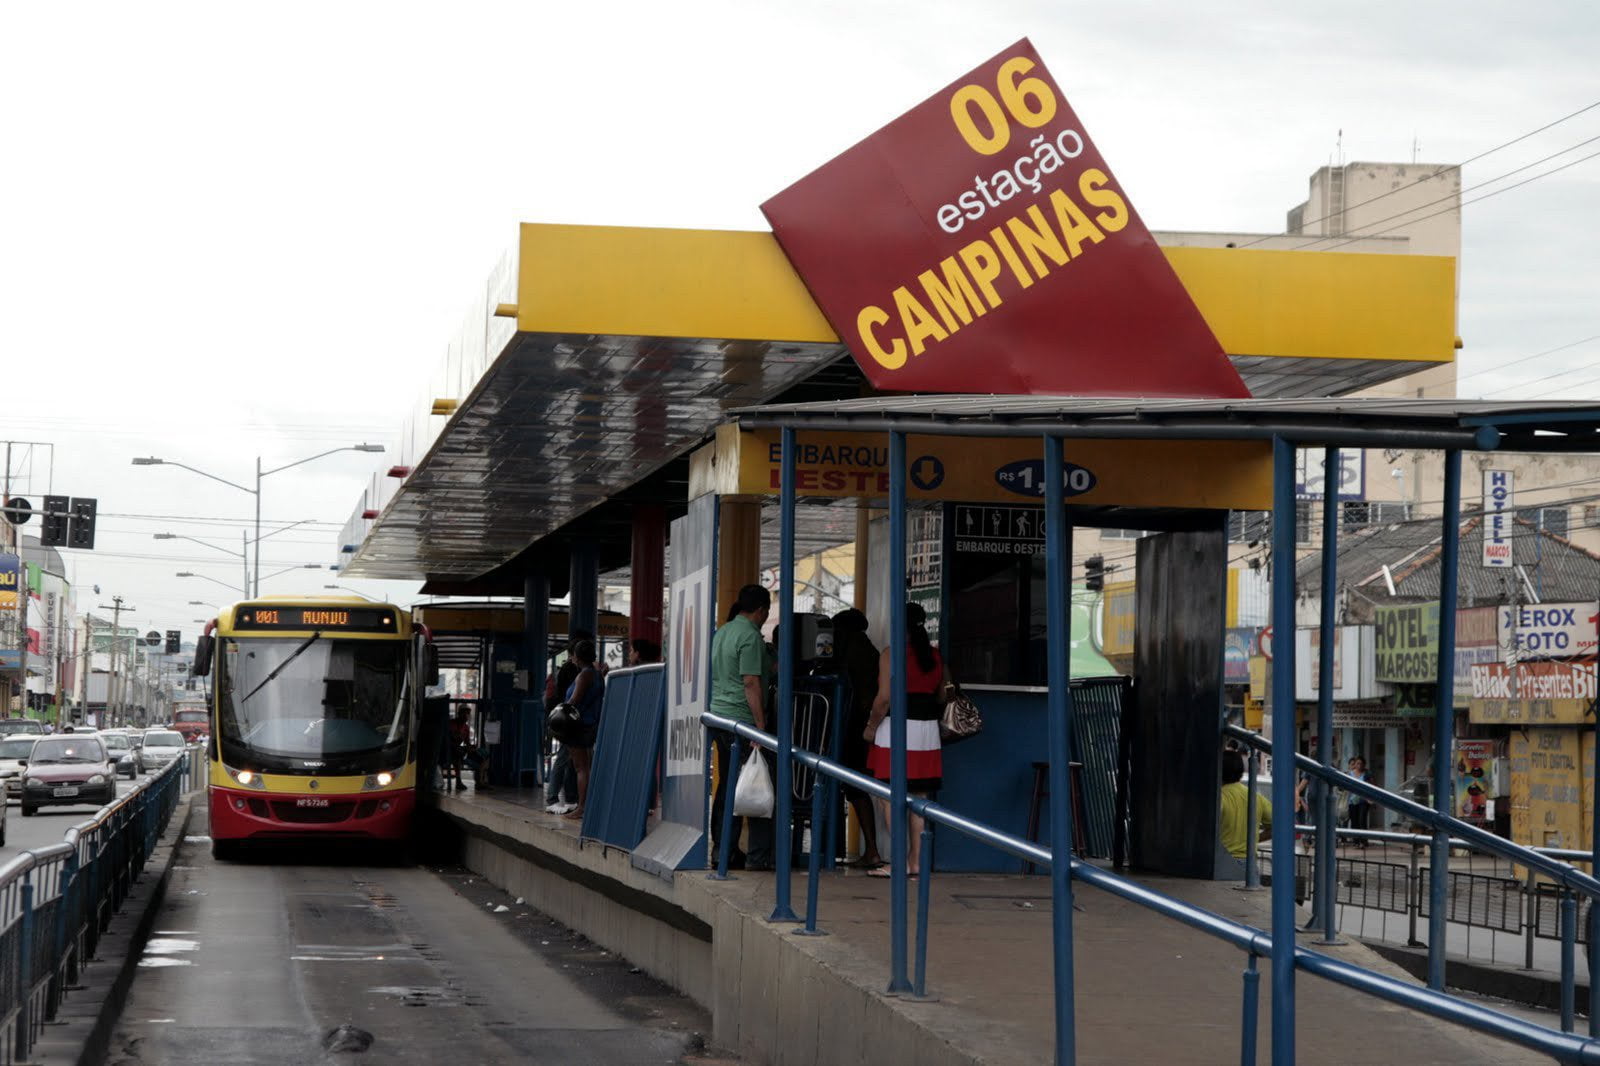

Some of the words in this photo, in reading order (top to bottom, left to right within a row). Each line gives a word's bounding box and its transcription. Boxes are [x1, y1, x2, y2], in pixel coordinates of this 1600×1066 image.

[950, 56, 1057, 155] 06
[936, 128, 1084, 233] estação
[857, 168, 1129, 370] CAMPINAS
[769, 443, 889, 467] EBARQU
[1000, 472, 1015, 482] R$
[1018, 467, 1090, 494] 1,0
[1492, 472, 1507, 544] HOTEL
[956, 541, 1011, 554] EMBARQUE
[1014, 543, 1046, 555] OESTE
[1486, 546, 1510, 557] MARCOS
[255, 611, 278, 624] 001
[1375, 607, 1427, 650] HOTEL
[1516, 631, 1569, 650] FOTO
[1376, 651, 1430, 679] MARCOS
